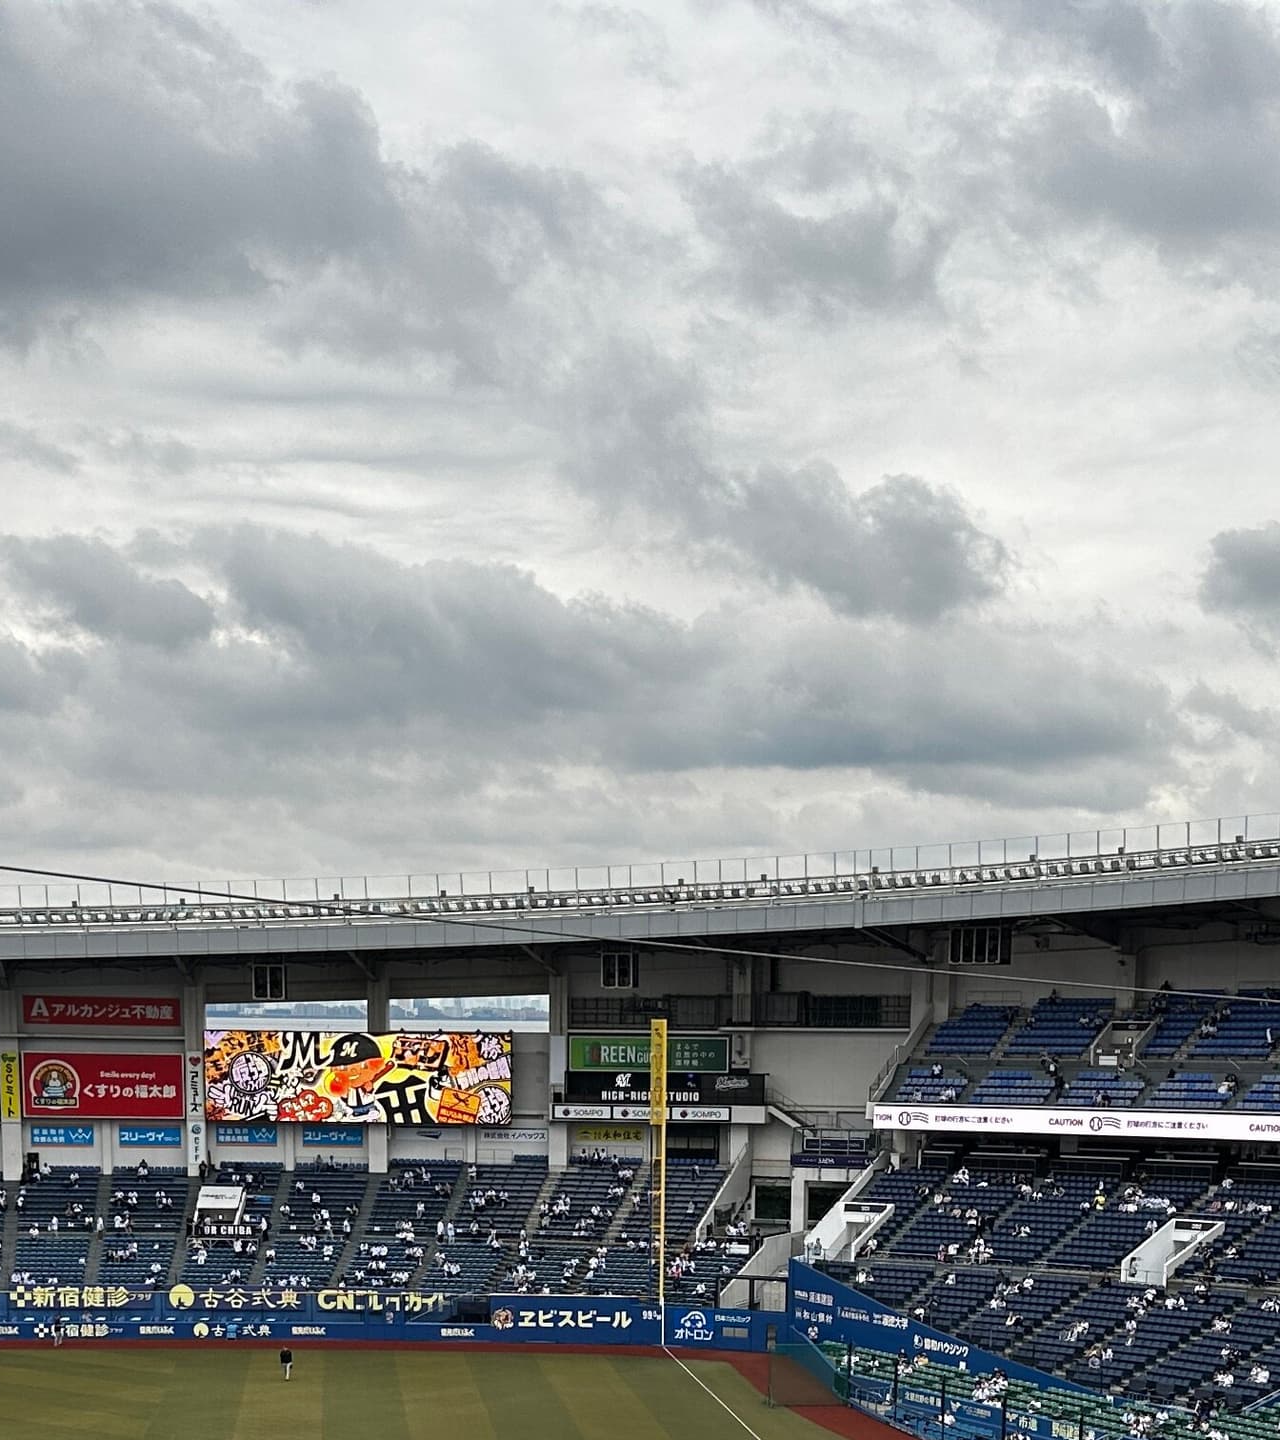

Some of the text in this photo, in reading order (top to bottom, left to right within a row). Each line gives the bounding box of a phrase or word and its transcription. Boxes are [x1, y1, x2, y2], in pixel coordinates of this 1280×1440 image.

[51, 1003, 174, 1020] アルカンジュ不動産
[5, 1062, 16, 1118] SCミート
[83, 1083, 177, 1099] くすりの福太郎
[601, 1090, 661, 1101] HIGH-RIG
[573, 1109, 604, 1117] SOMPO
[691, 1110, 722, 1118] SOMPO
[1048, 1117, 1084, 1128] CAUTION
[518, 1310, 633, 1329] ヱビスビール
[211, 1323, 272, 1338] 古式典
[674, 1328, 714, 1341] オトロン
